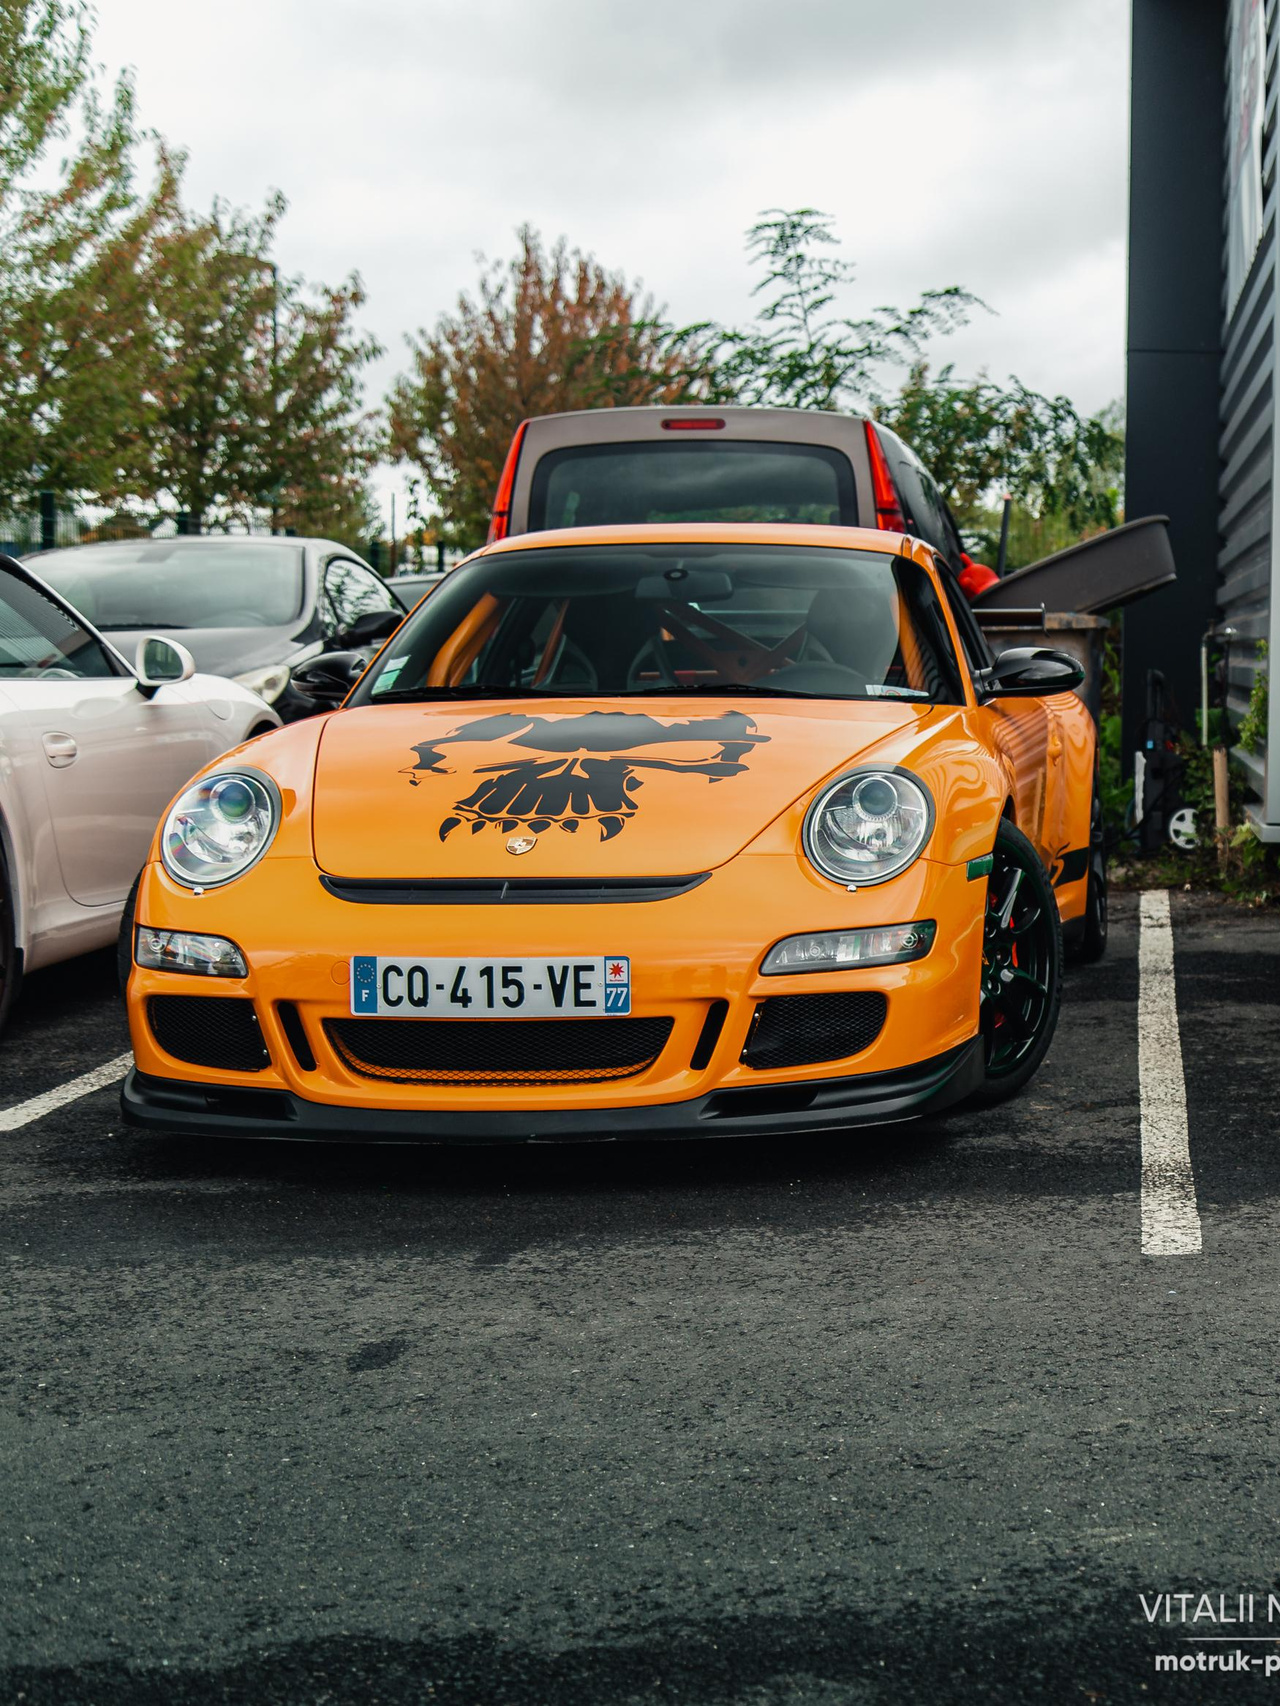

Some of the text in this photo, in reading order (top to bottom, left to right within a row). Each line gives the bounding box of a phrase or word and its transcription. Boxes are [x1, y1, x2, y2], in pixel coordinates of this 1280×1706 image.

[361, 989, 370, 1002] F
[382, 964, 597, 1008] CQ-415-VE
[606, 987, 628, 1007] 77
